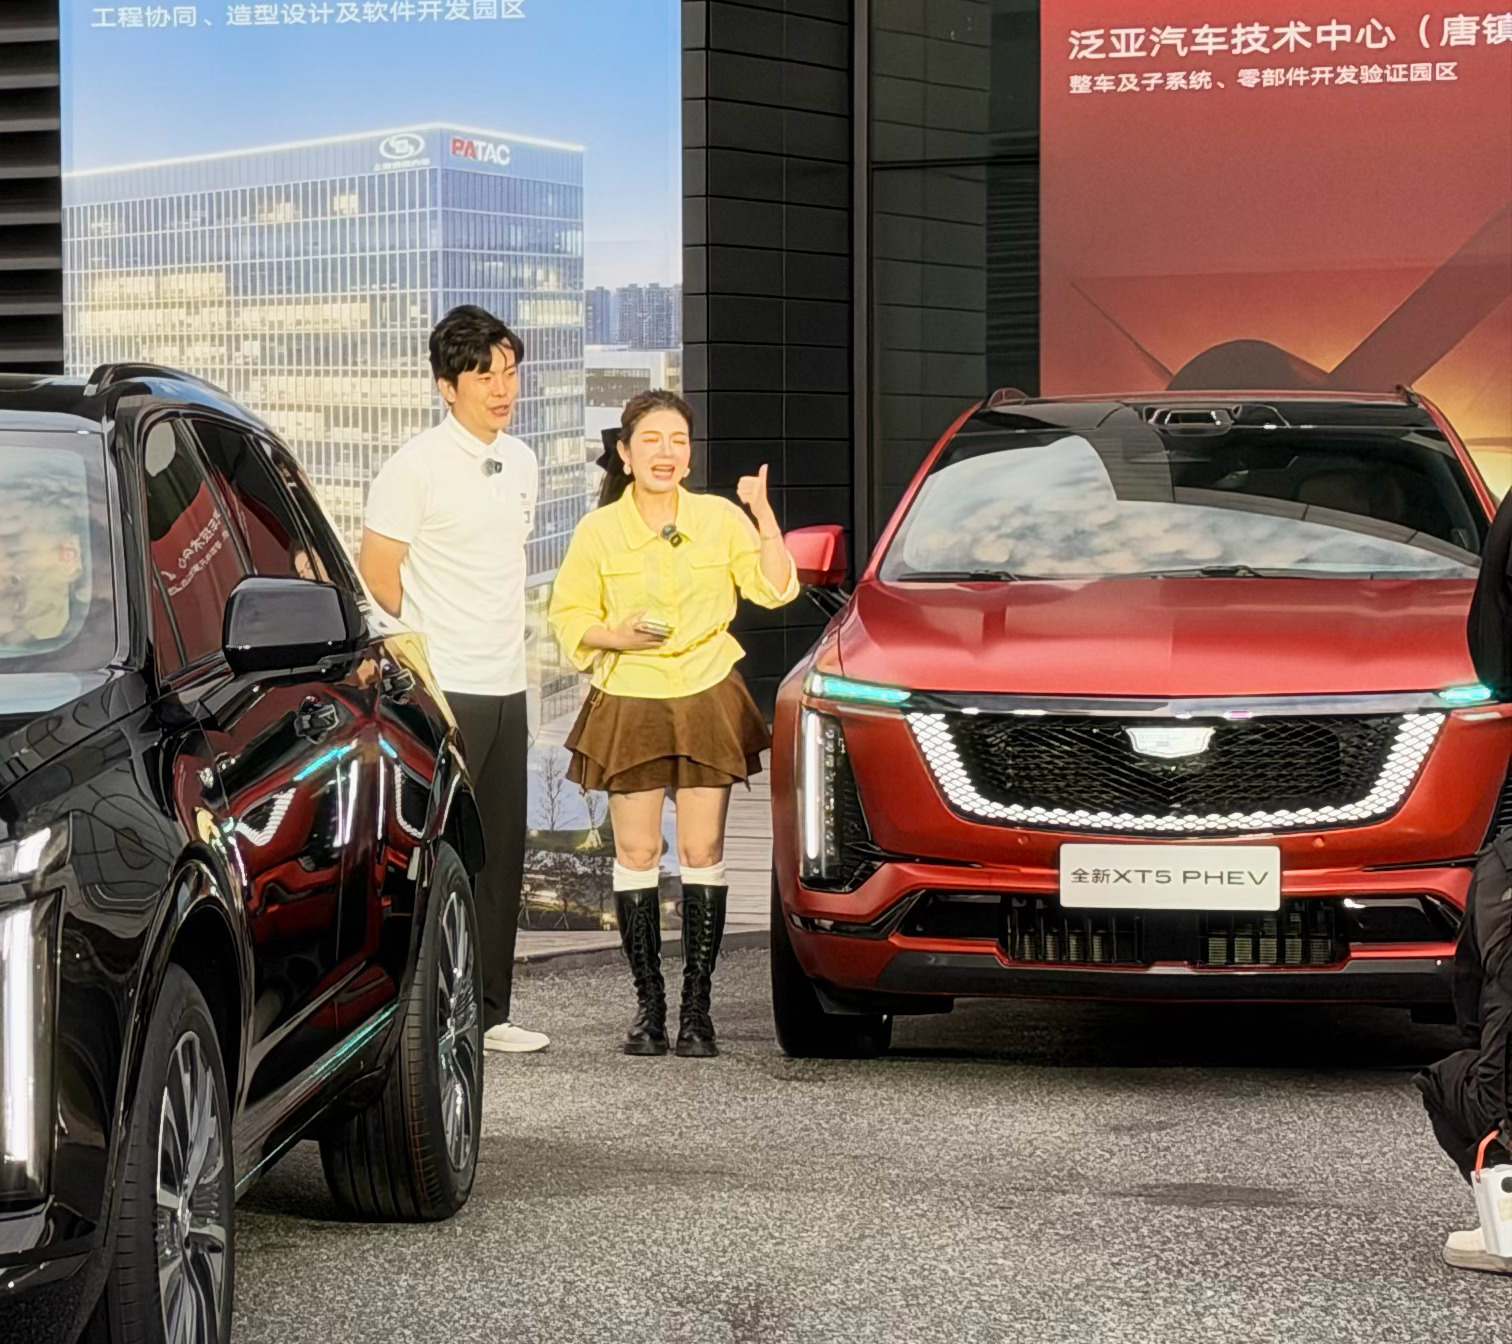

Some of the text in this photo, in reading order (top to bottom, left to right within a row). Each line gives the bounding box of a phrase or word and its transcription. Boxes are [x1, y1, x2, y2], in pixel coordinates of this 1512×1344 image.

[1068, 12, 1512, 60] 泛亚汽车技术中心（唐镇
[1069, 61, 1459, 94] 整车及子系统、零部件开发验证园区
[451, 137, 511, 166] PATAC
[1071, 867, 1269, 886] 全新XT5 PHEV
